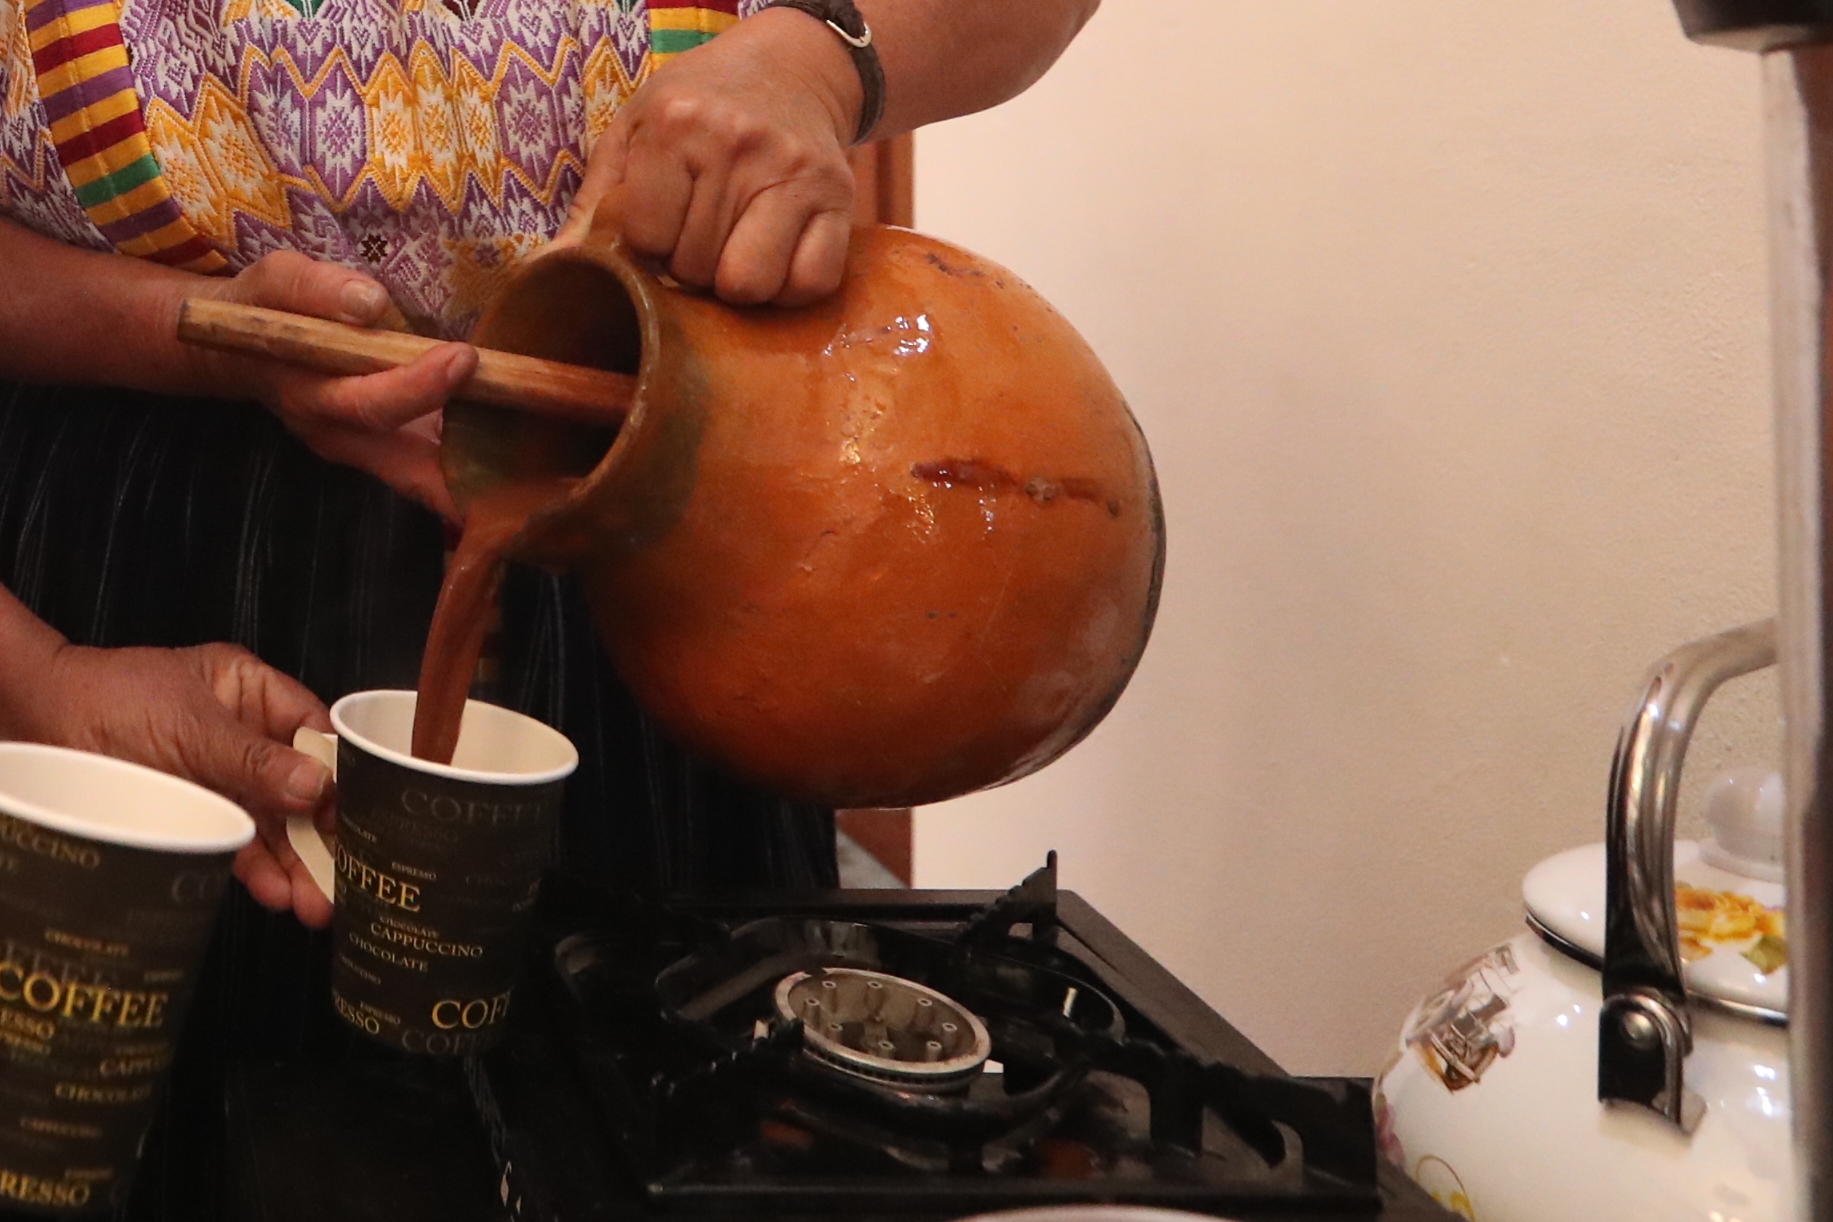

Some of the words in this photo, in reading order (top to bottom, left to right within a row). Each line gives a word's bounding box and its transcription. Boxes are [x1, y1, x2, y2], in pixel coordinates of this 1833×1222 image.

[336, 844, 421, 912] OFFEE
[370, 921, 484, 958] CAPPUCCINO
[379, 915, 439, 939] CHOCOLATE
[348, 931, 428, 973] CHOCOLATE
